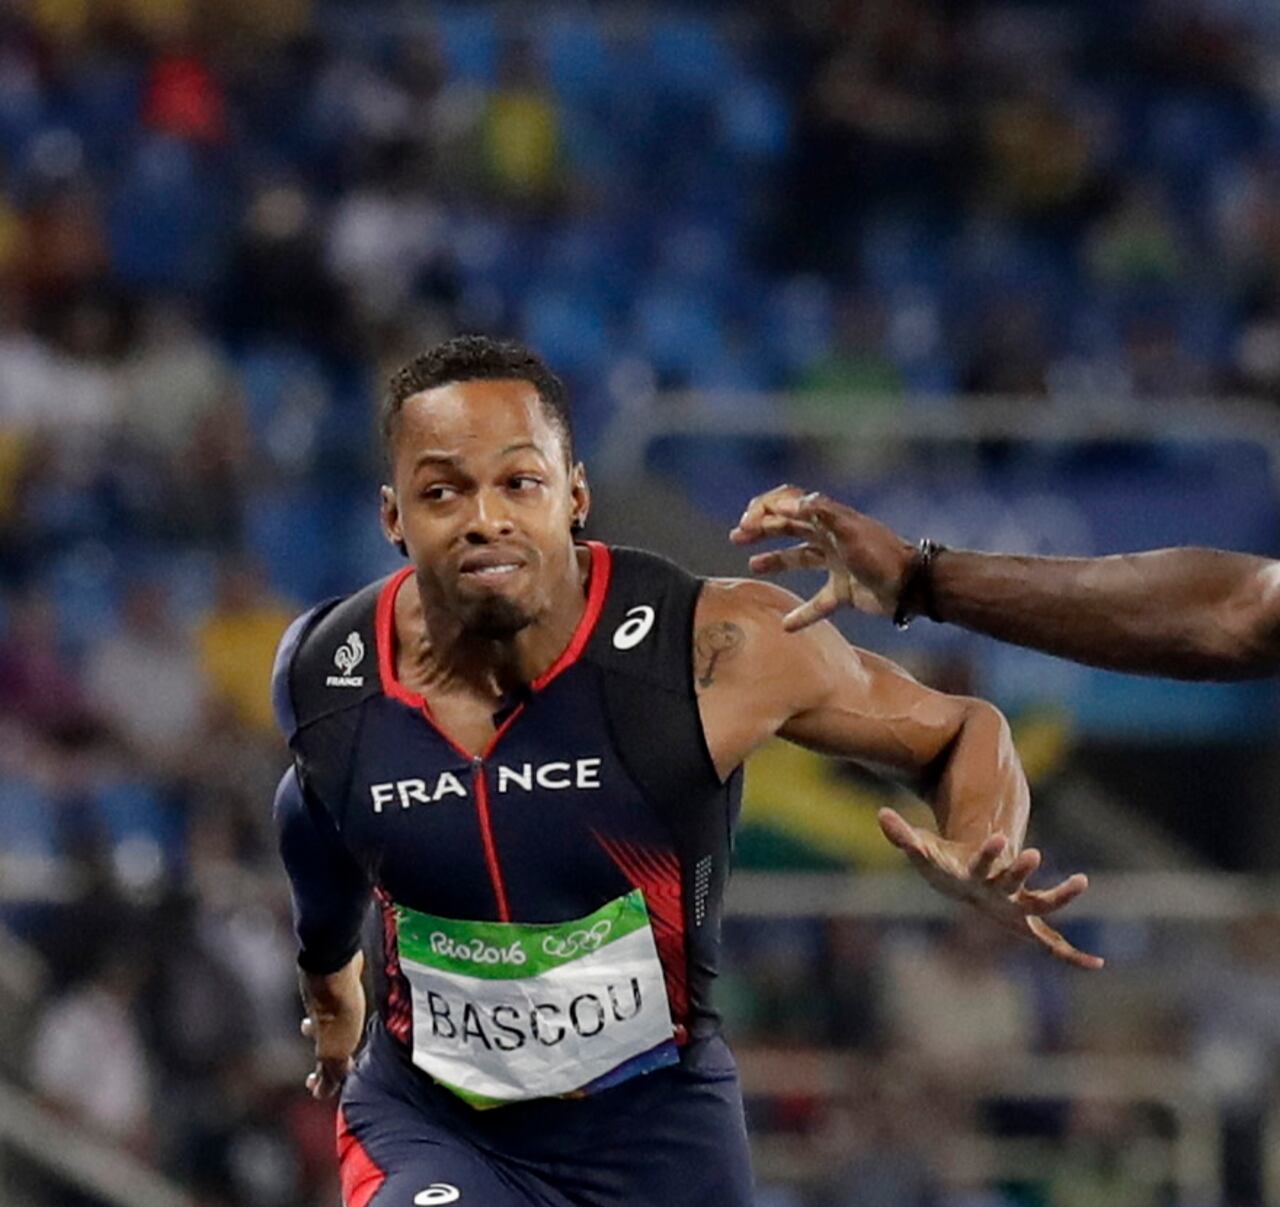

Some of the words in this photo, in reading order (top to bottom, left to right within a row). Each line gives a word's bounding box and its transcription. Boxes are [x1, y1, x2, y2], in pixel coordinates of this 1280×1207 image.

[326, 675, 364, 686] FRANCE
[429, 931, 526, 966] Rio2016
[426, 976, 642, 1051] BASCOU
